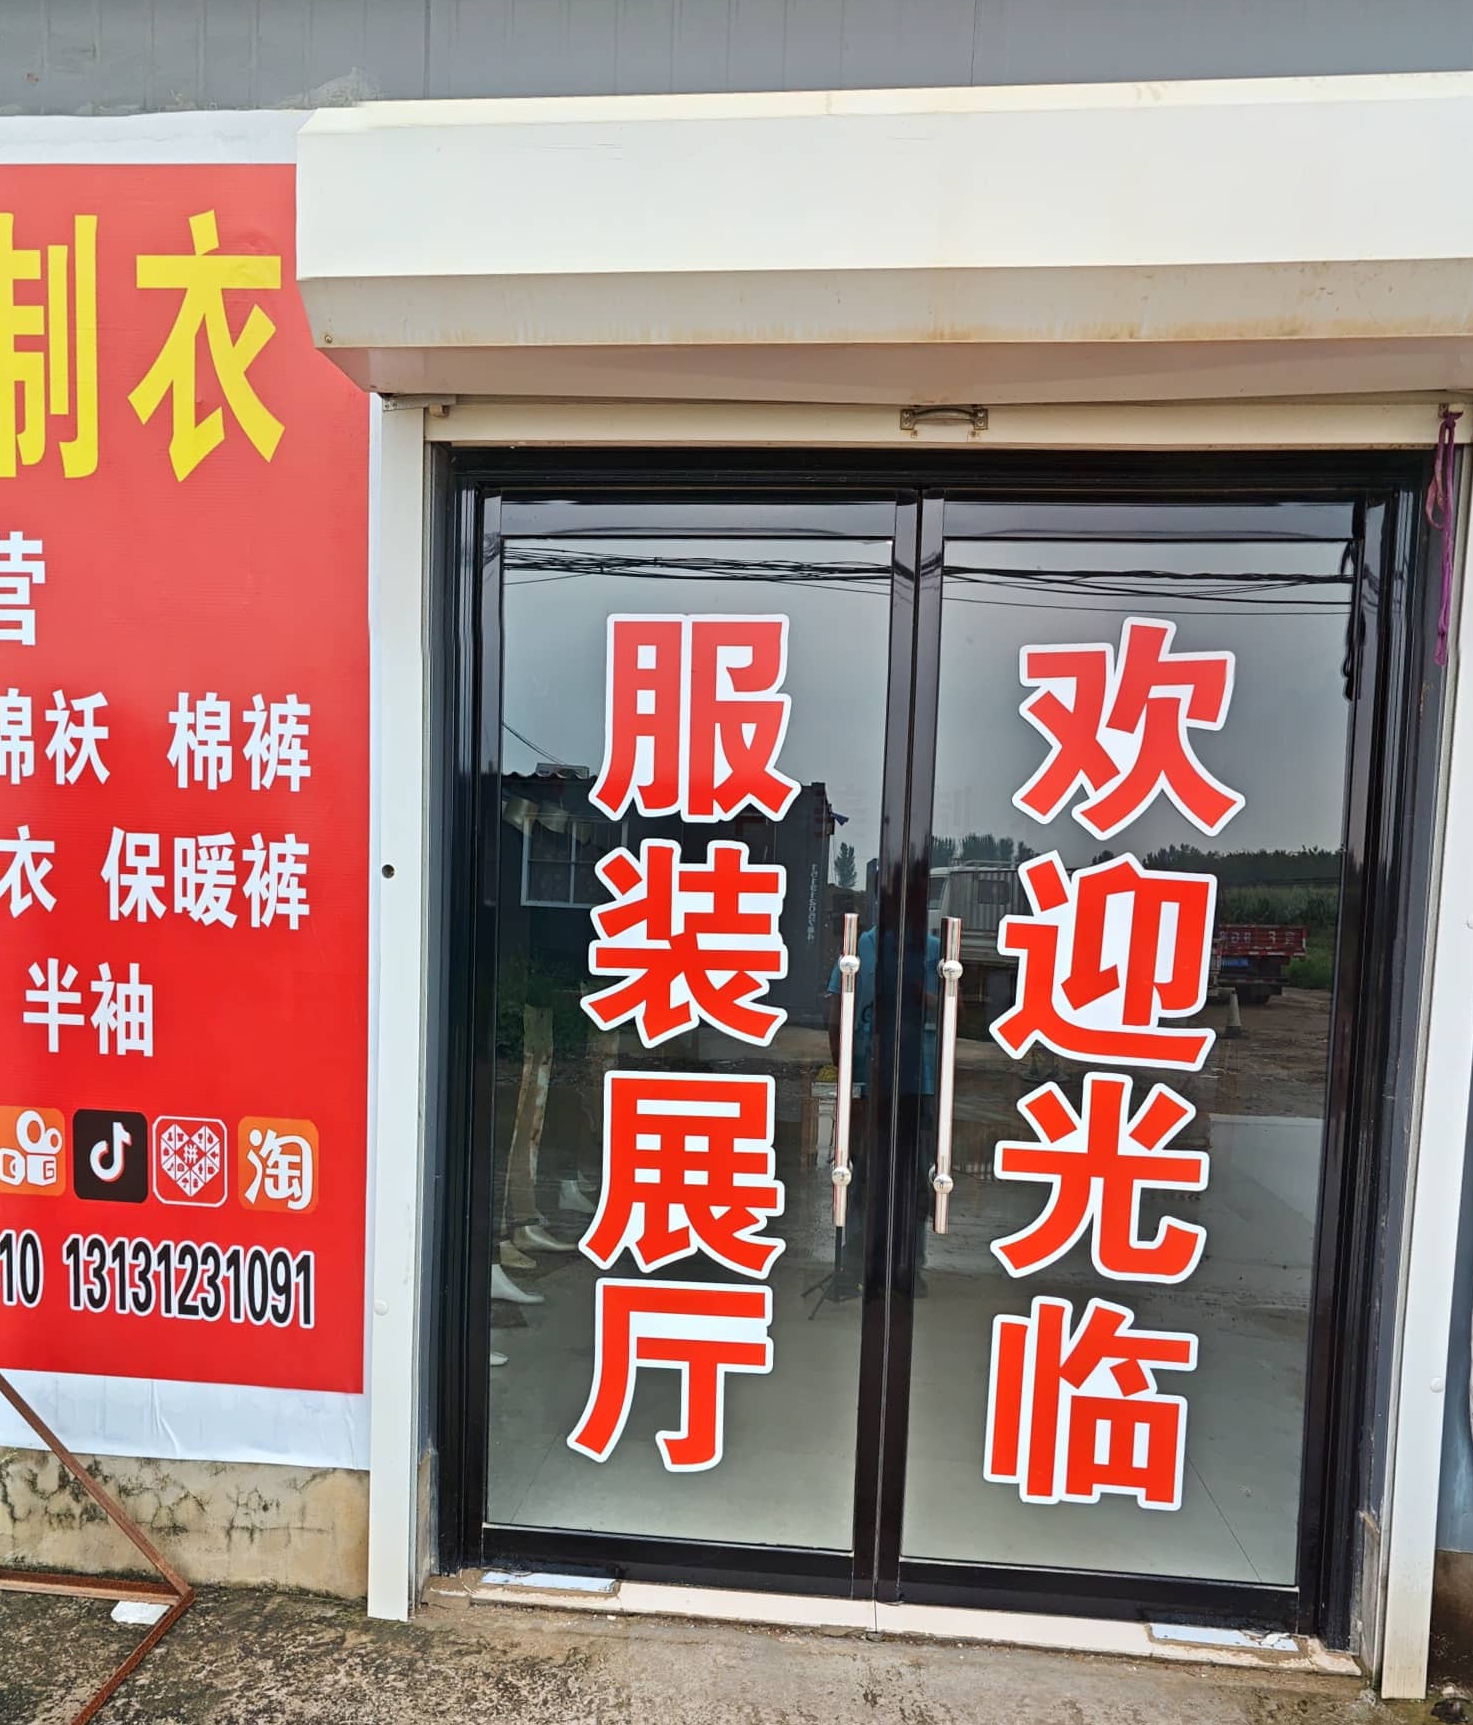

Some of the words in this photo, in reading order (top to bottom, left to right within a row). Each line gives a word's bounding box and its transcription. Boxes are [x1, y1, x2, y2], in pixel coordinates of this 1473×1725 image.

[167, 692, 311, 791] 棉裤
[101, 826, 310, 929] 保暖裤
[23, 957, 153, 1056] 半袖
[565, 613, 802, 1473] 服装展厅
[981, 617, 1246, 1510] 欢迎光临
[244, 1128, 313, 1210] 淘
[64, 1236, 316, 1328] 13131231091
